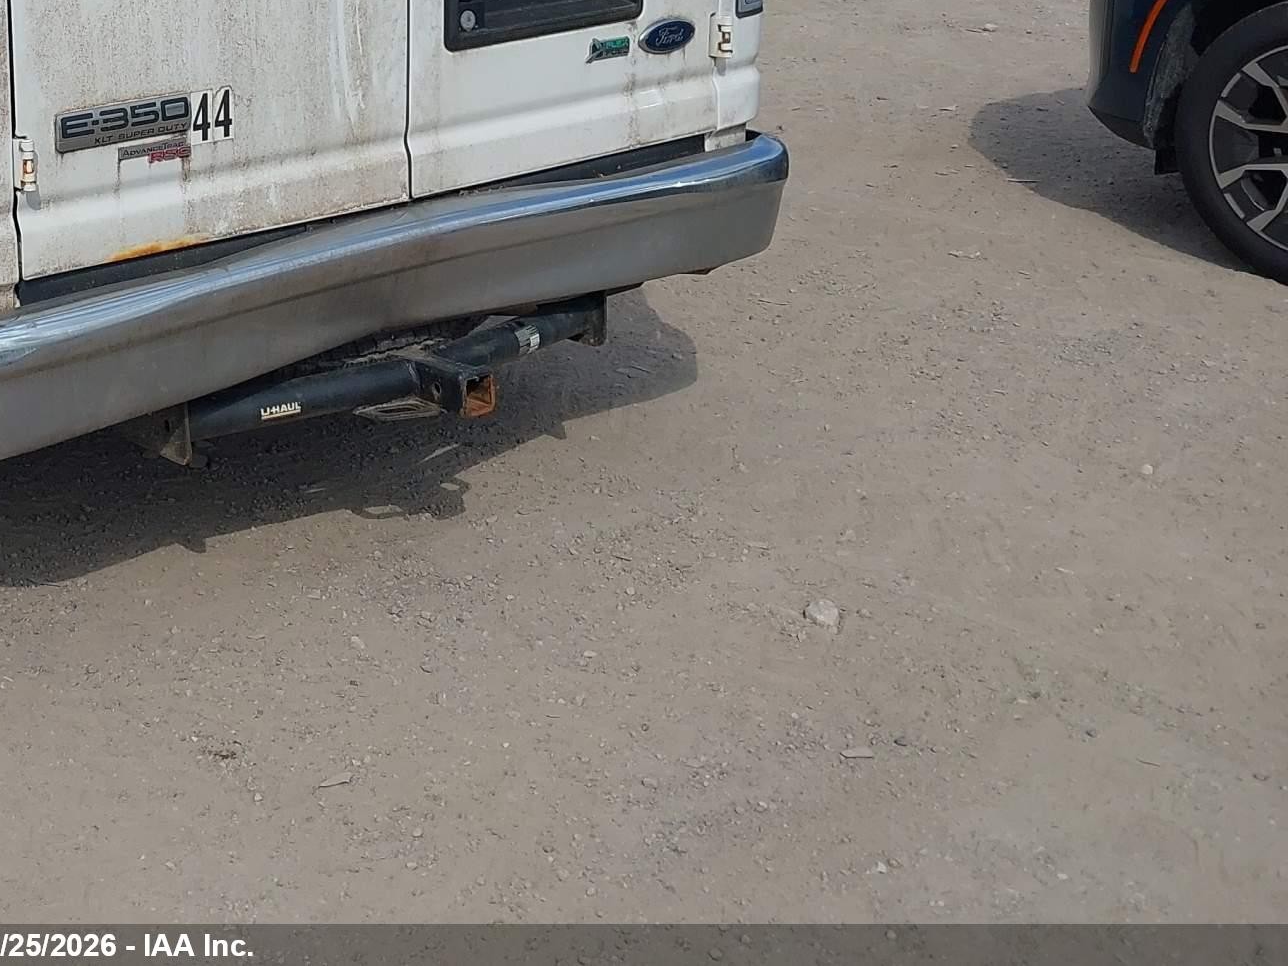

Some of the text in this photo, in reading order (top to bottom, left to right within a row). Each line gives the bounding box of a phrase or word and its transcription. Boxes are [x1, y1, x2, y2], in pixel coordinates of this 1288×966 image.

[655, 27, 685, 47] Ford
[192, 89, 233, 141] 44
[93, 122, 188, 145] XLT SUPER DUTY
[260, 401, 302, 417] U-HAUL
